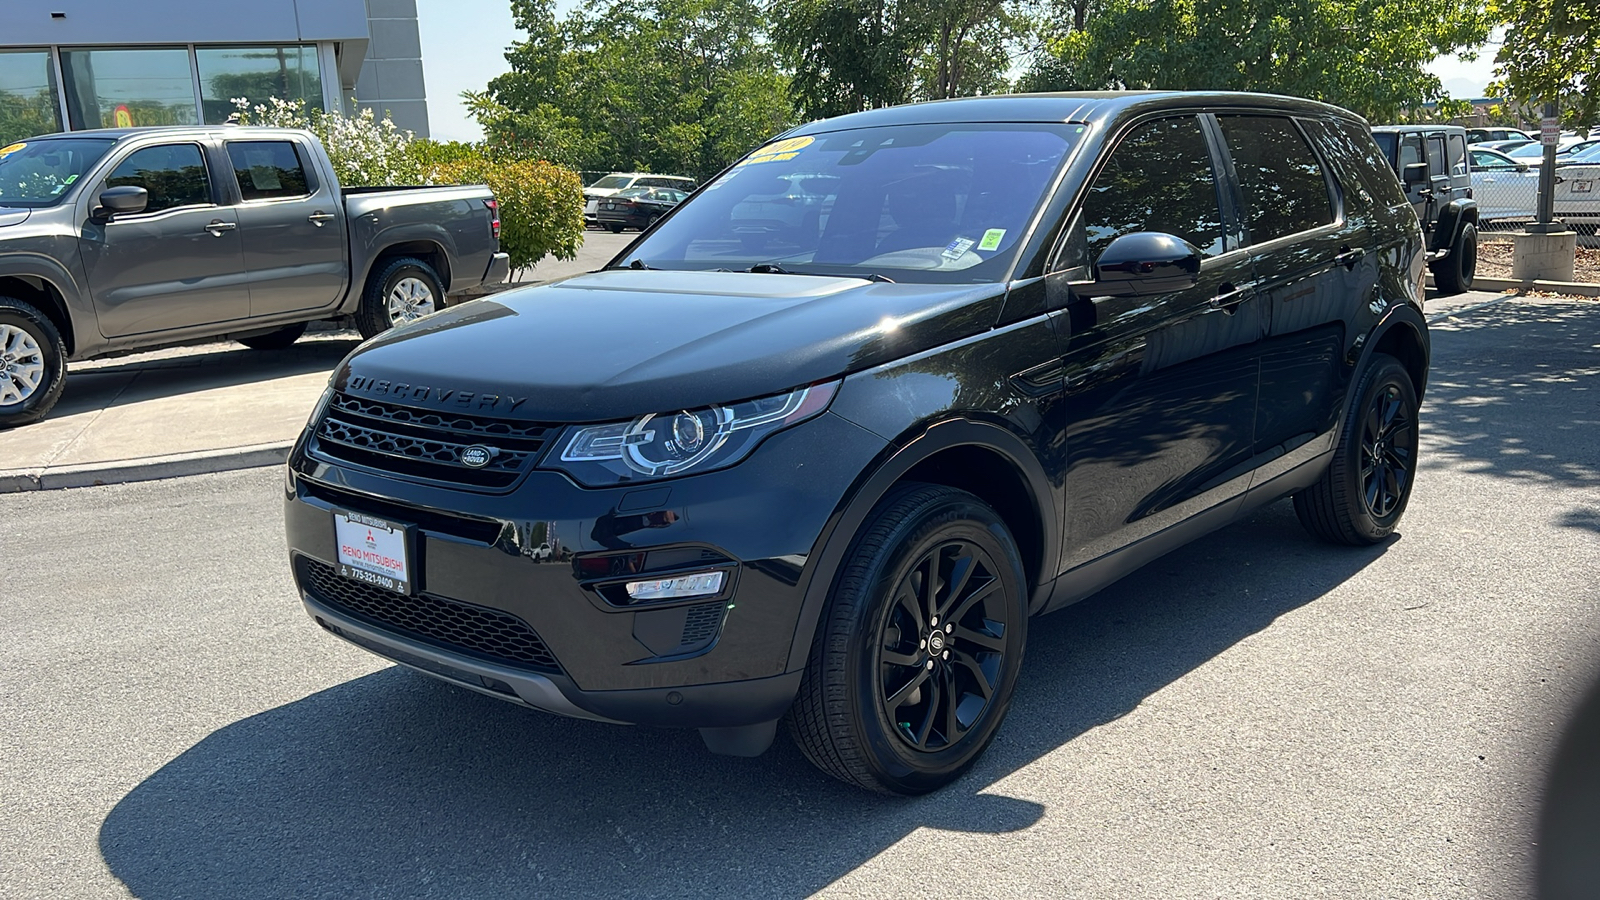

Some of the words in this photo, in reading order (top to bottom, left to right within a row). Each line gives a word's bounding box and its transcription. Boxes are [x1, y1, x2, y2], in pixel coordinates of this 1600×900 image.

[350, 375, 528, 413] DISCOVERY
[348, 512, 362, 523] RENO
[361, 515, 388, 529] MITSUBISHI
[342, 545, 362, 559] RENO
[362, 550, 404, 572] MITSUBISHI
[351, 568, 393, 589] 775-321-9400
